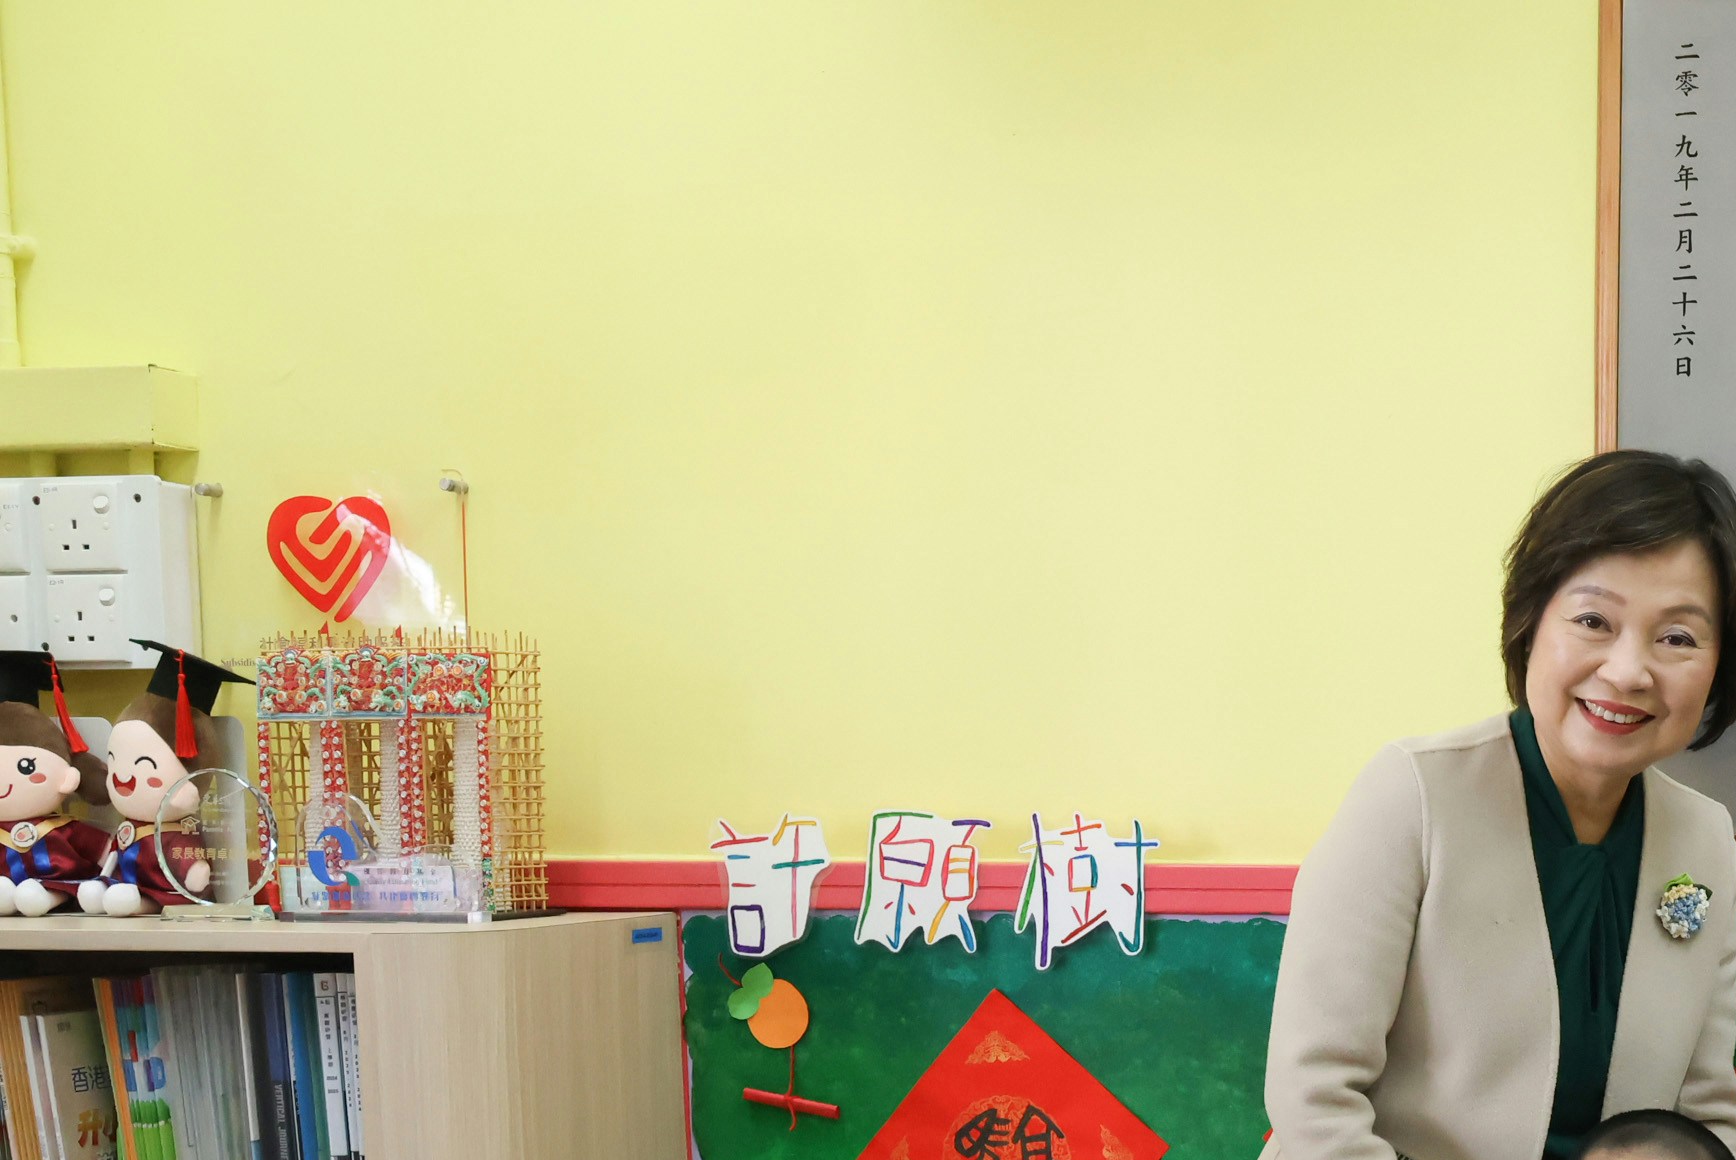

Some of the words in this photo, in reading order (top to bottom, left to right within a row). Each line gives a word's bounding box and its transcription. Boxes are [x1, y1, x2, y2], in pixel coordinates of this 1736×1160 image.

[1672, 44, 1700, 377] 二零一九年二月二十六日
[710, 812, 1159, 968] 許願樹
